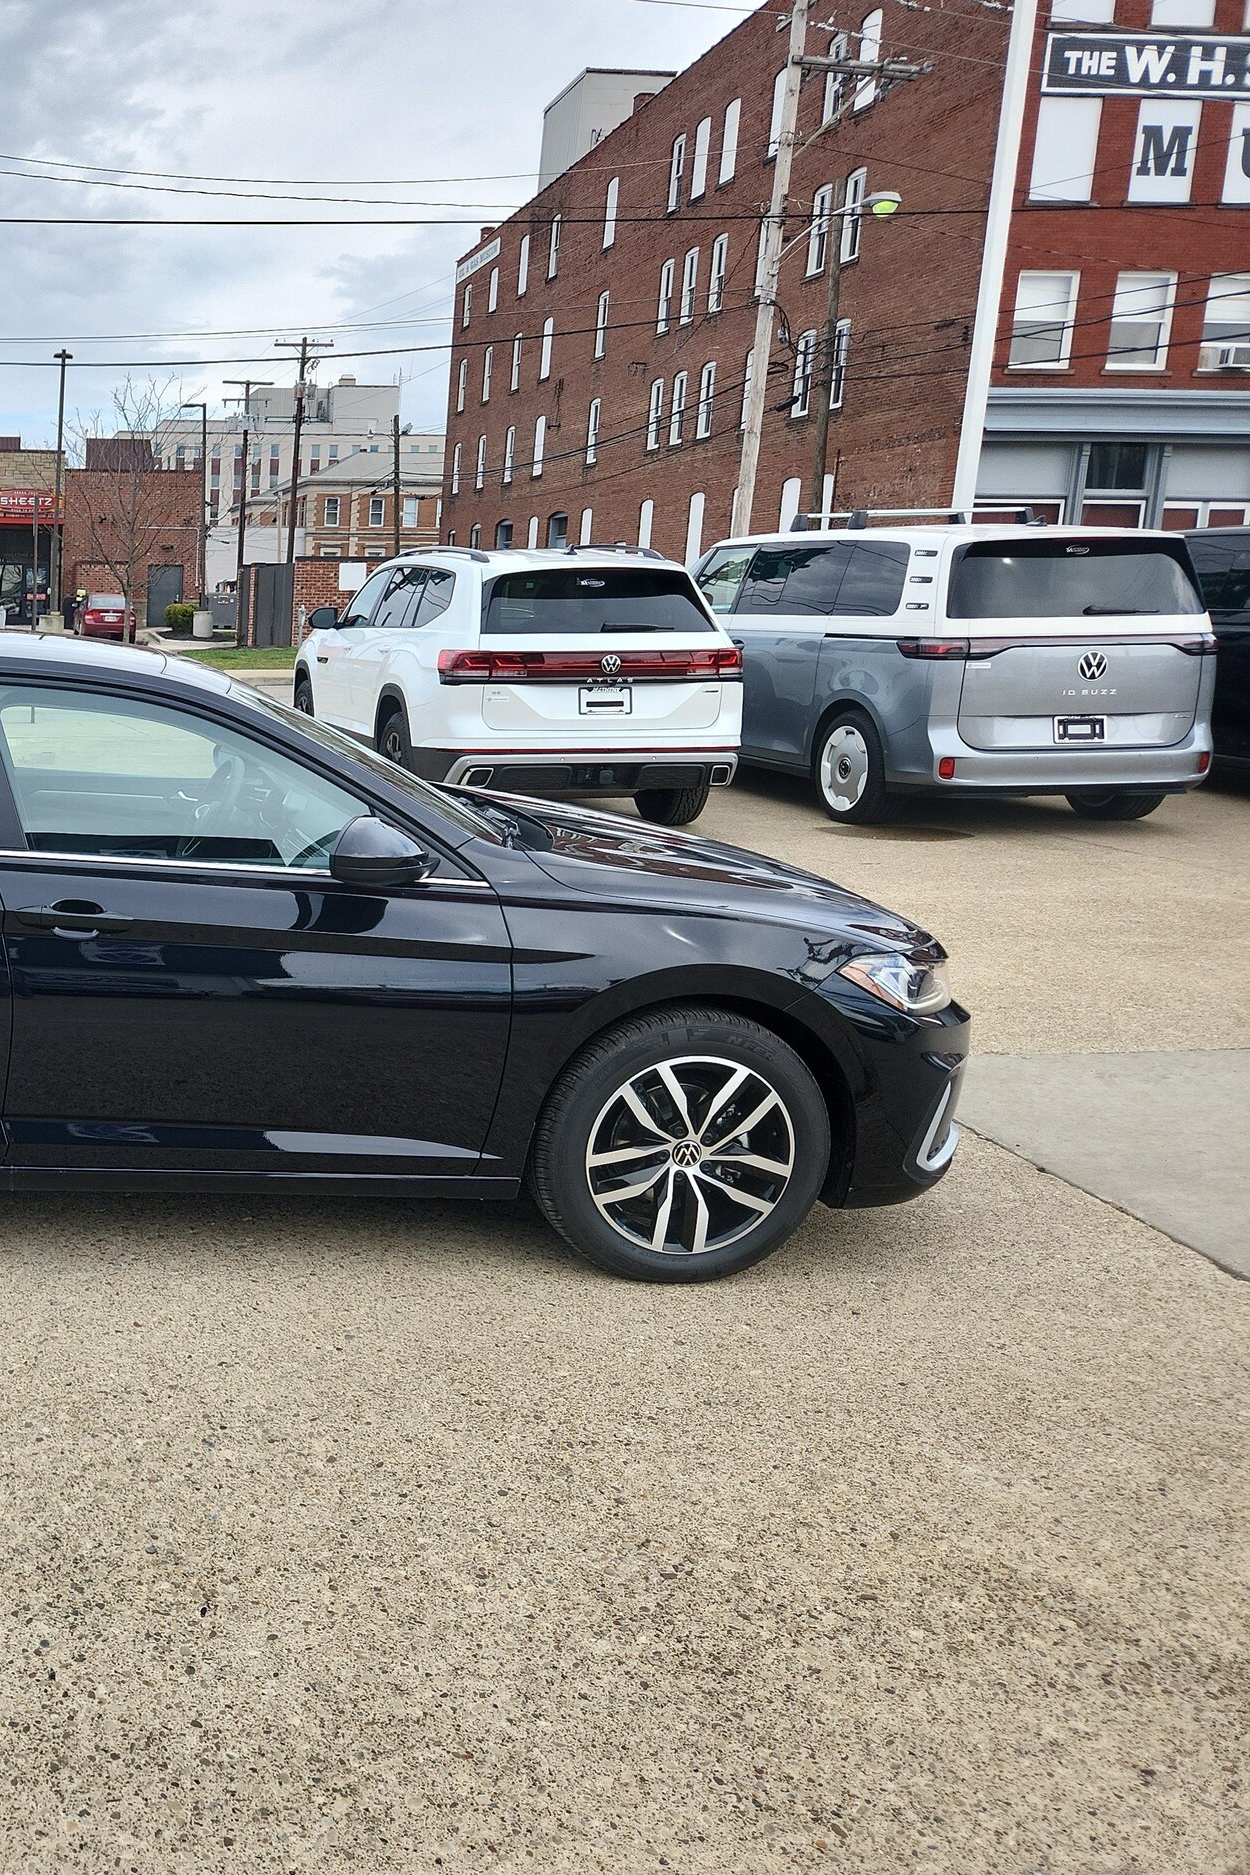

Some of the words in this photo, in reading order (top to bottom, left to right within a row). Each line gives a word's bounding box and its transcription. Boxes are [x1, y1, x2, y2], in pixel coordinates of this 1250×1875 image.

[1063, 50, 1118, 76] THE
[0, 496, 53, 506] SHEETZ
[1081, 688, 1117, 696] BUZZ
